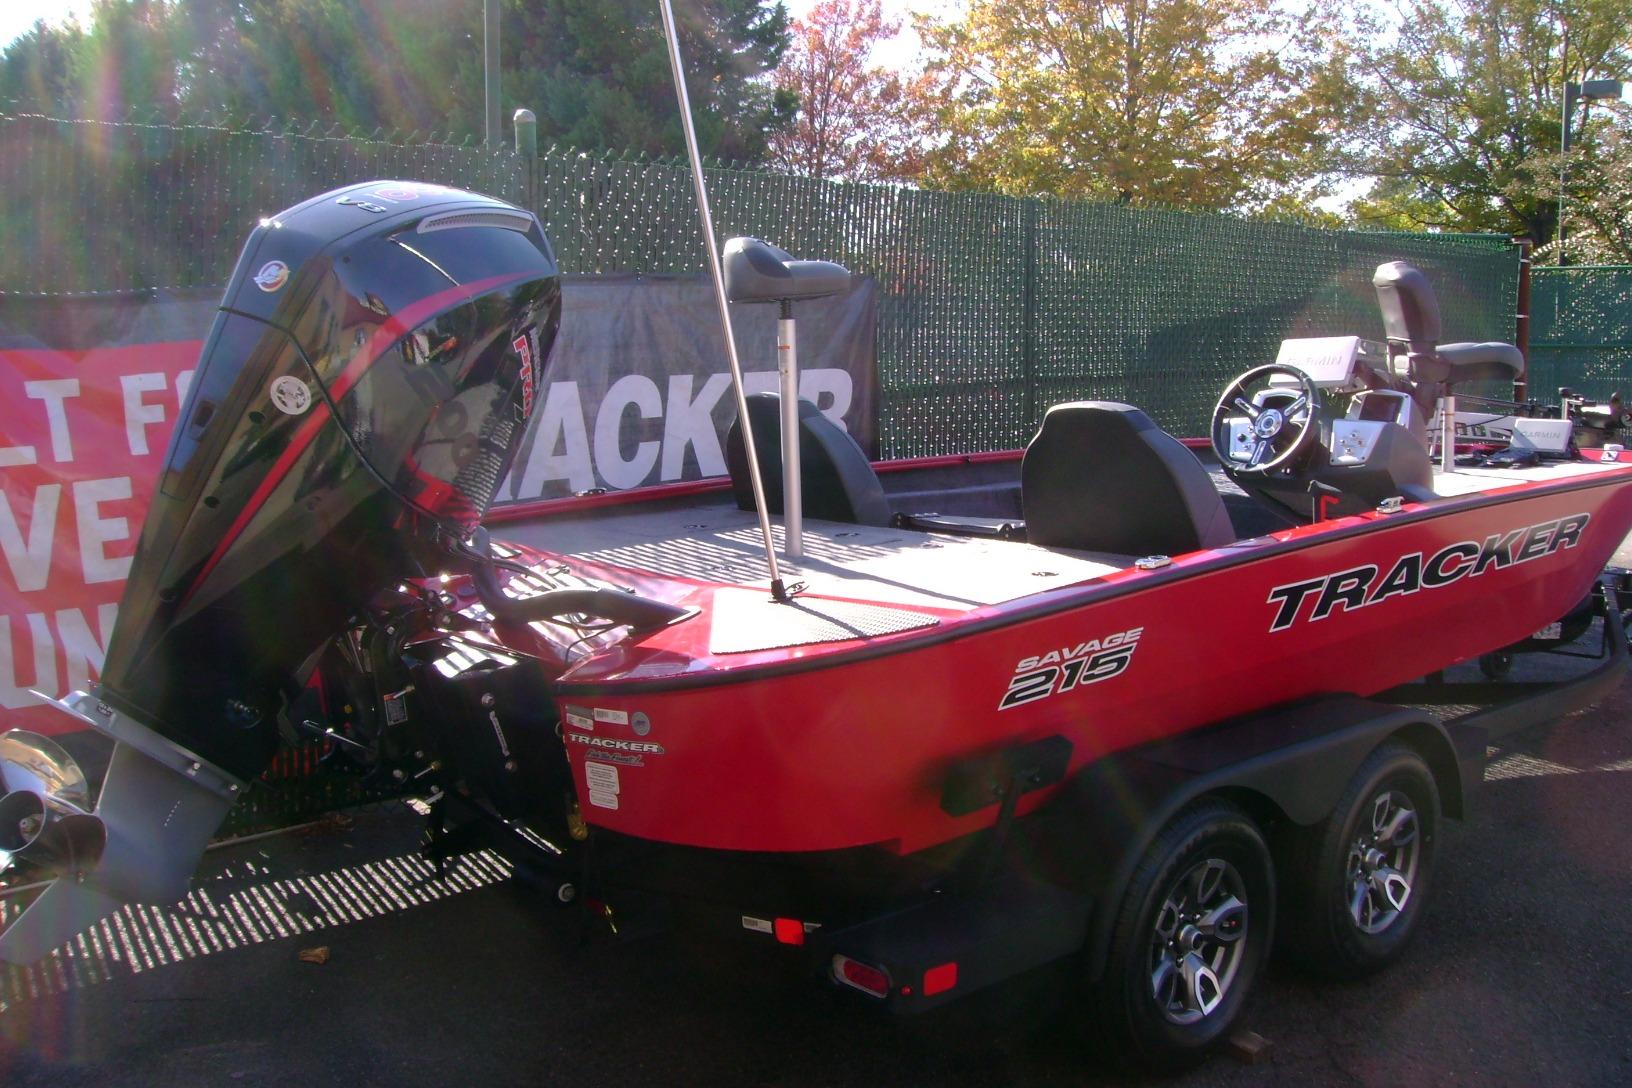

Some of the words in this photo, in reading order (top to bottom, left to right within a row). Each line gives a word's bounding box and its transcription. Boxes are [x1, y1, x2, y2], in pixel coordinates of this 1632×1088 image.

[120, 370, 194, 456] F
[494, 369, 853, 500] ACKR
[1267, 513, 1590, 632] TRACKER
[998, 642, 1137, 711] 215
[1015, 627, 1144, 673] SAVAGE
[568, 733, 660, 753] TRACKER
